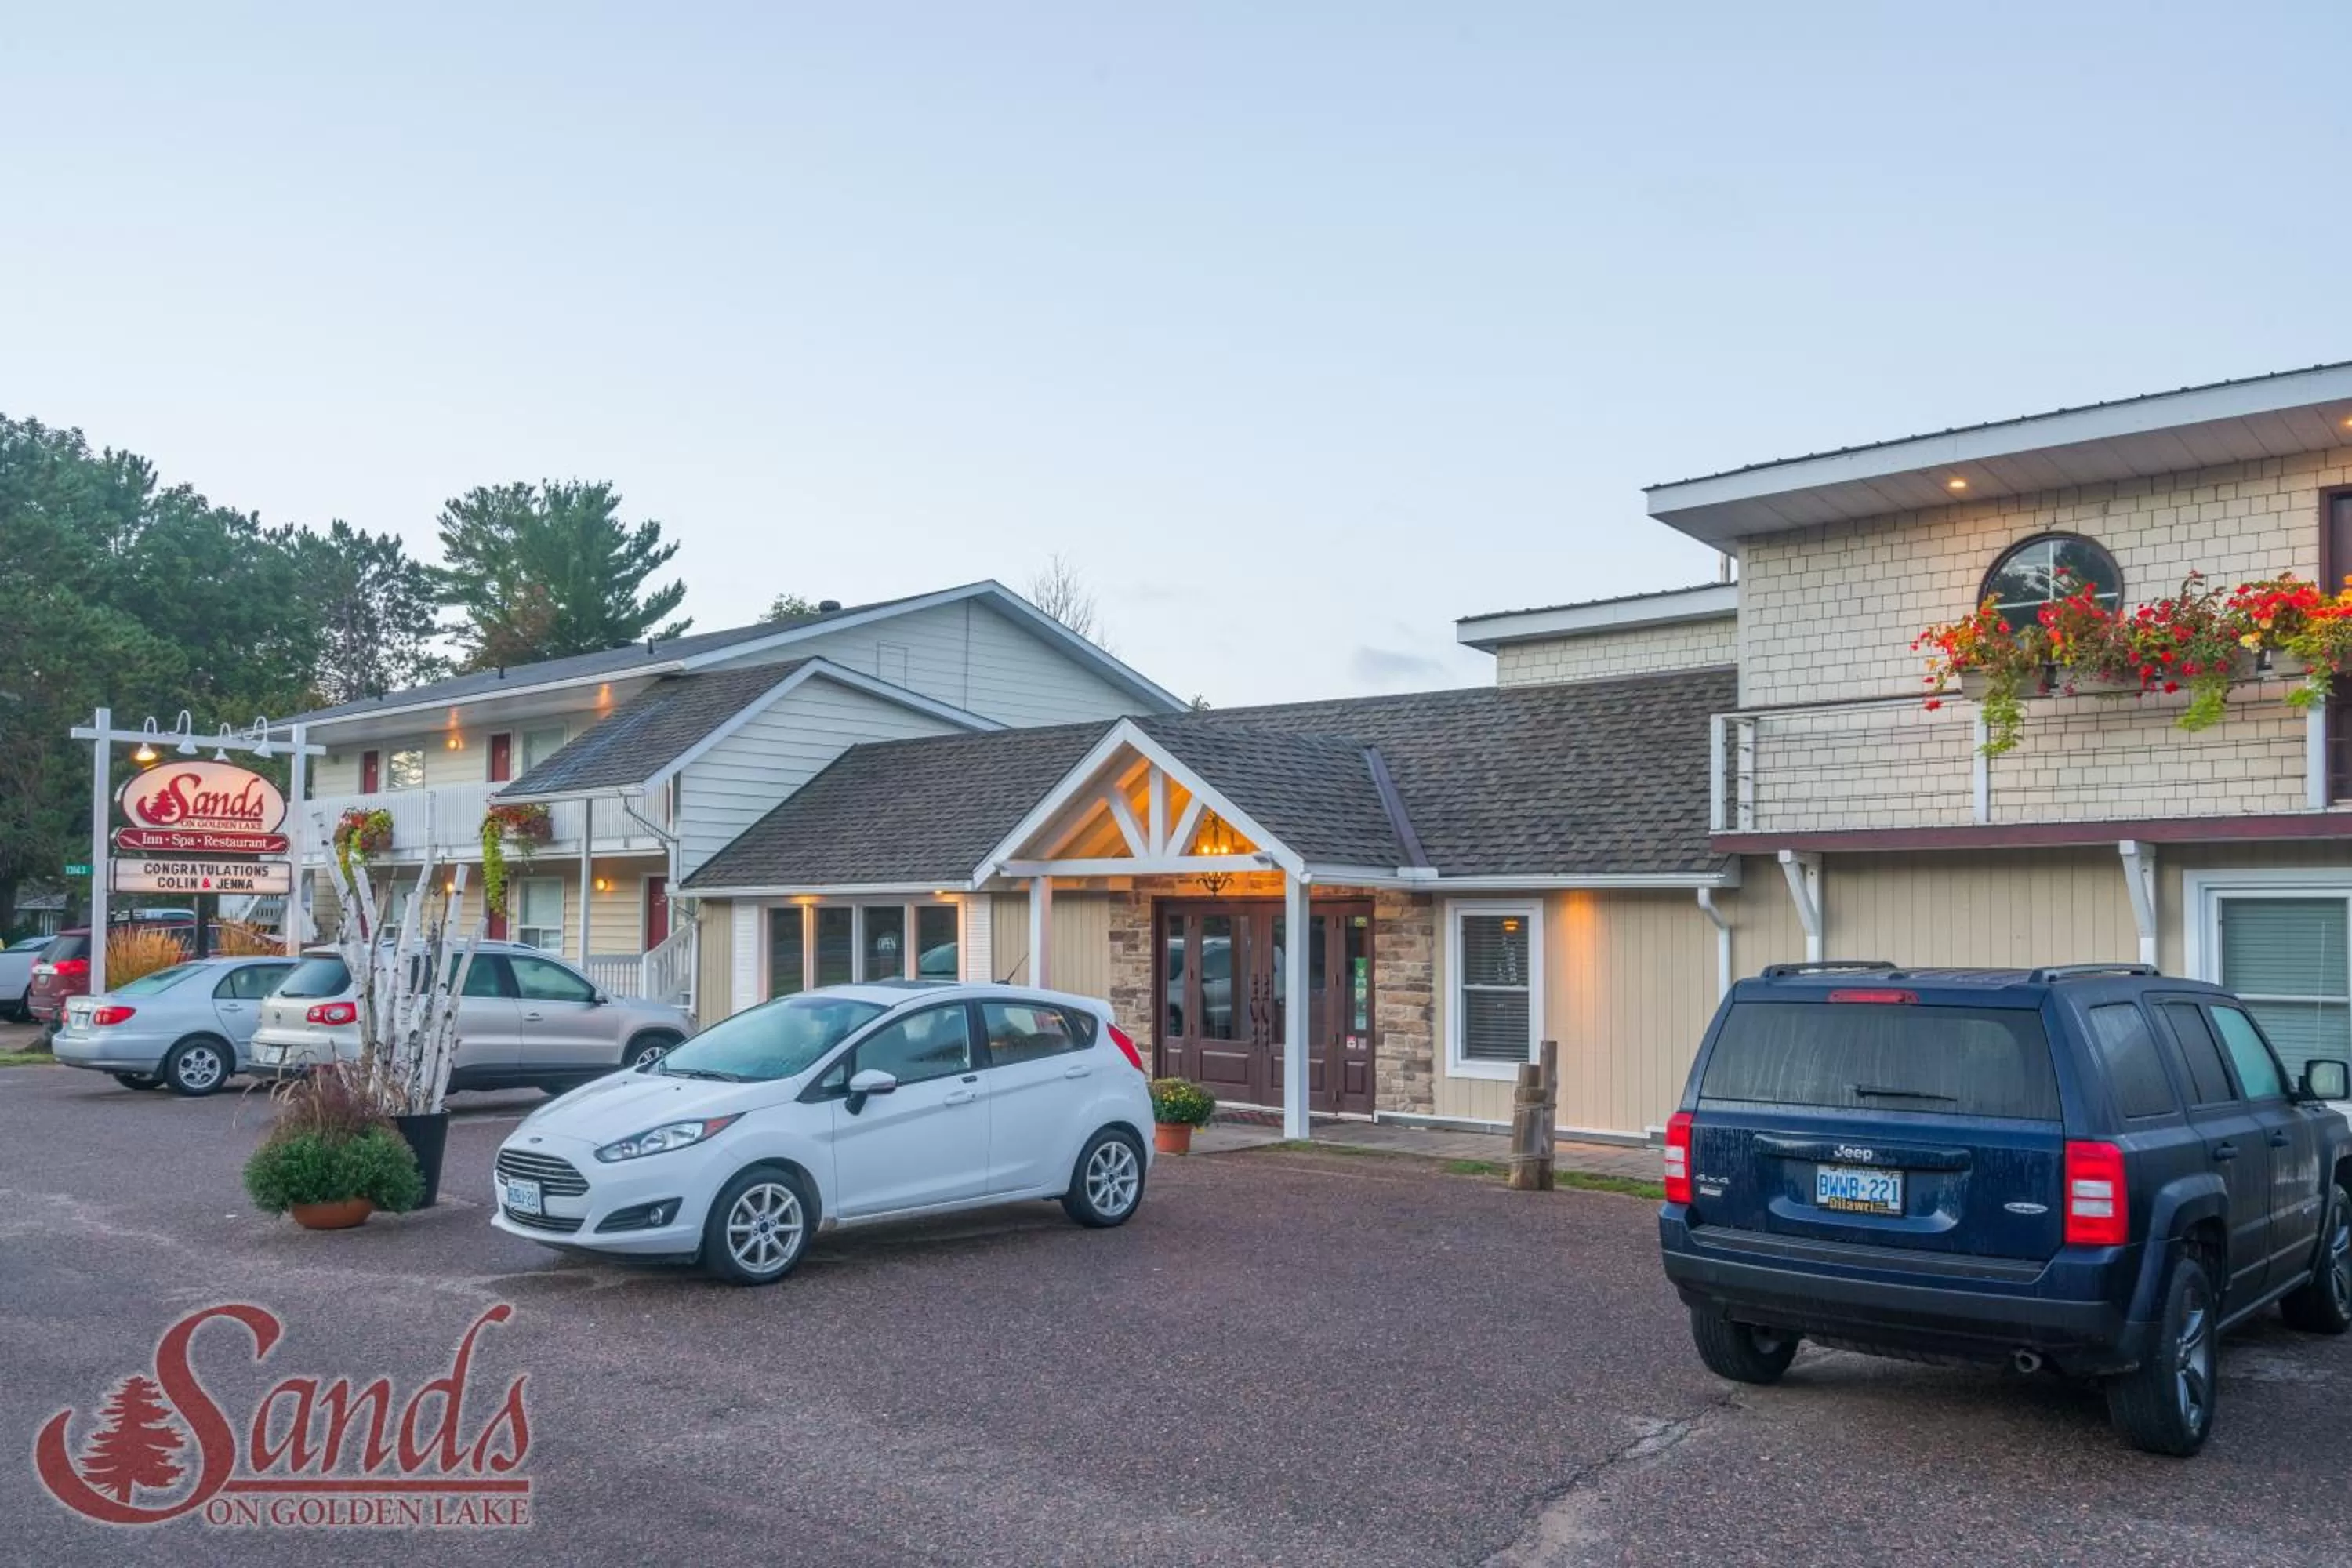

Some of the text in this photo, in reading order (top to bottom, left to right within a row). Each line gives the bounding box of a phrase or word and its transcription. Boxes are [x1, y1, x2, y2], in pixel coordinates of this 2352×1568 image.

[136, 772, 263, 826] Sands
[181, 819, 262, 830] ON GOLDEN LAKE
[141, 833, 267, 848] Inn Spa Restaurant
[143, 863, 270, 877] CONGRATULATIONS
[157, 876, 254, 890] COLIN & JENNA
[1834, 1145, 1873, 1162] Jeep
